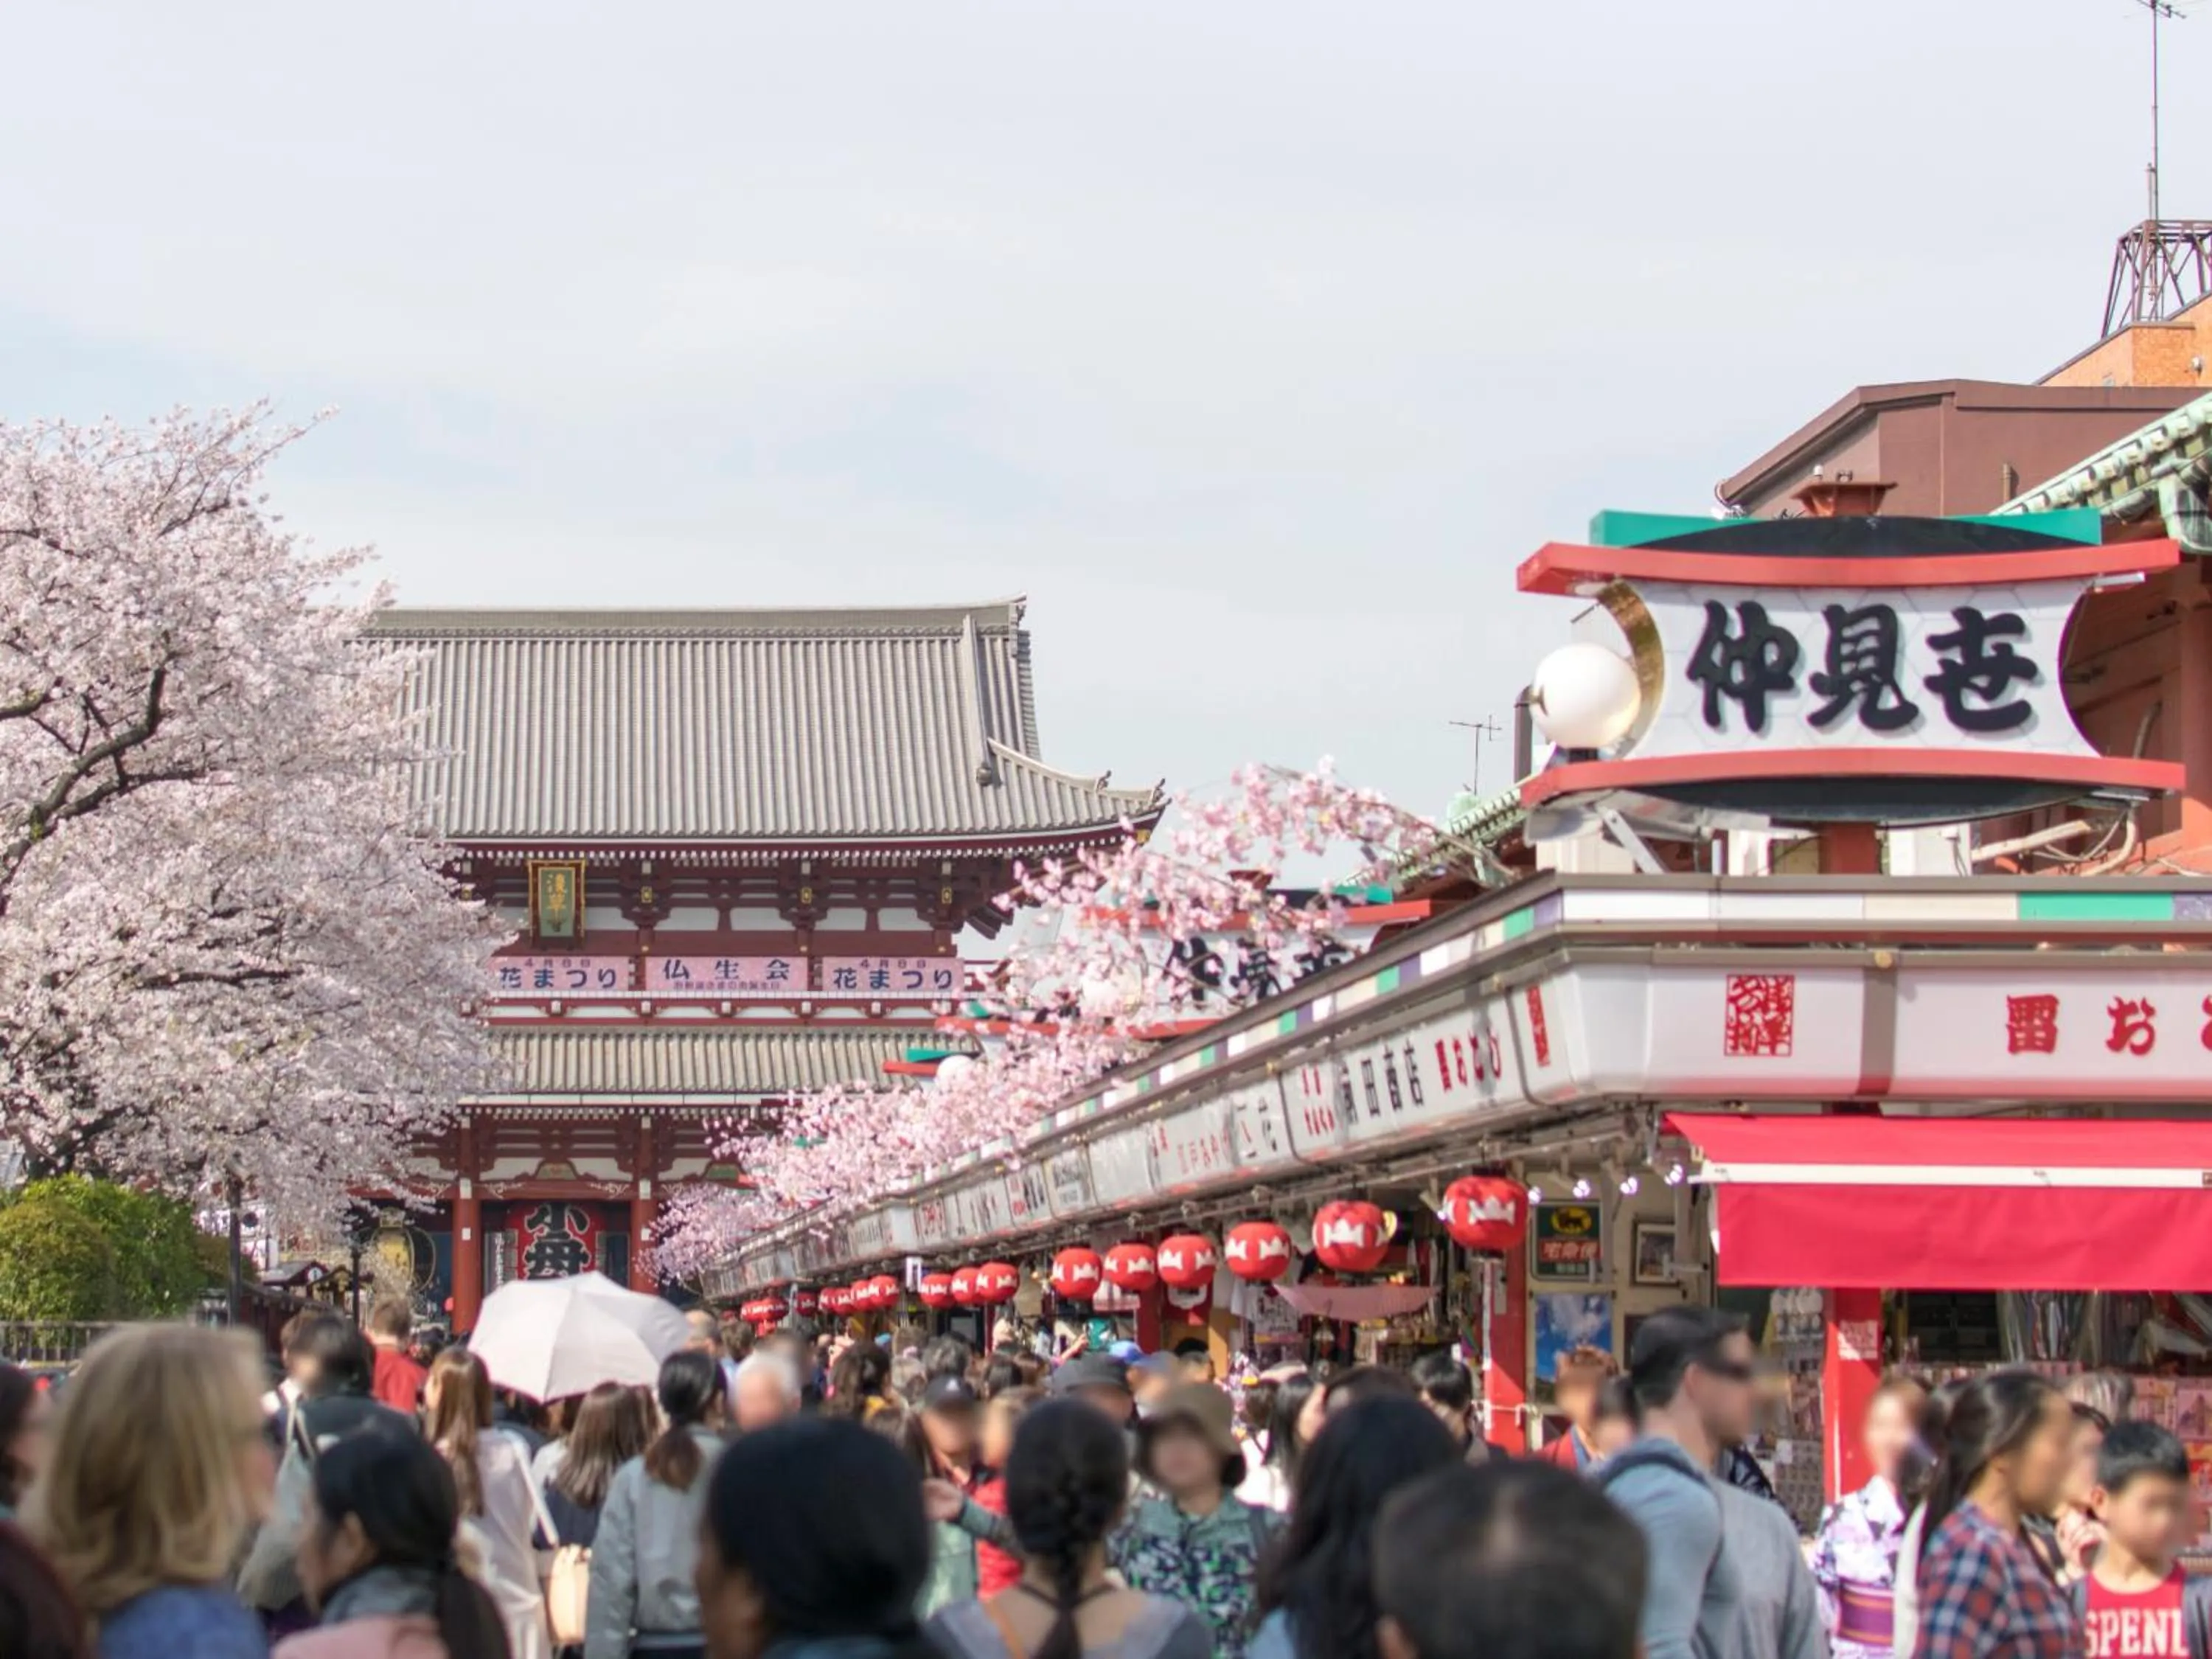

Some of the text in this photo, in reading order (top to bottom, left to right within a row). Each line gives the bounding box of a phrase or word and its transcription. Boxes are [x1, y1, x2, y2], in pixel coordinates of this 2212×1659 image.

[1686, 599, 2038, 733] 仲見世
[500, 967, 616, 989] 花まつり
[664, 959, 790, 980] 仏生会
[833, 967, 952, 990] 花まつり
[2006, 994, 2212, 1056] 雷お
